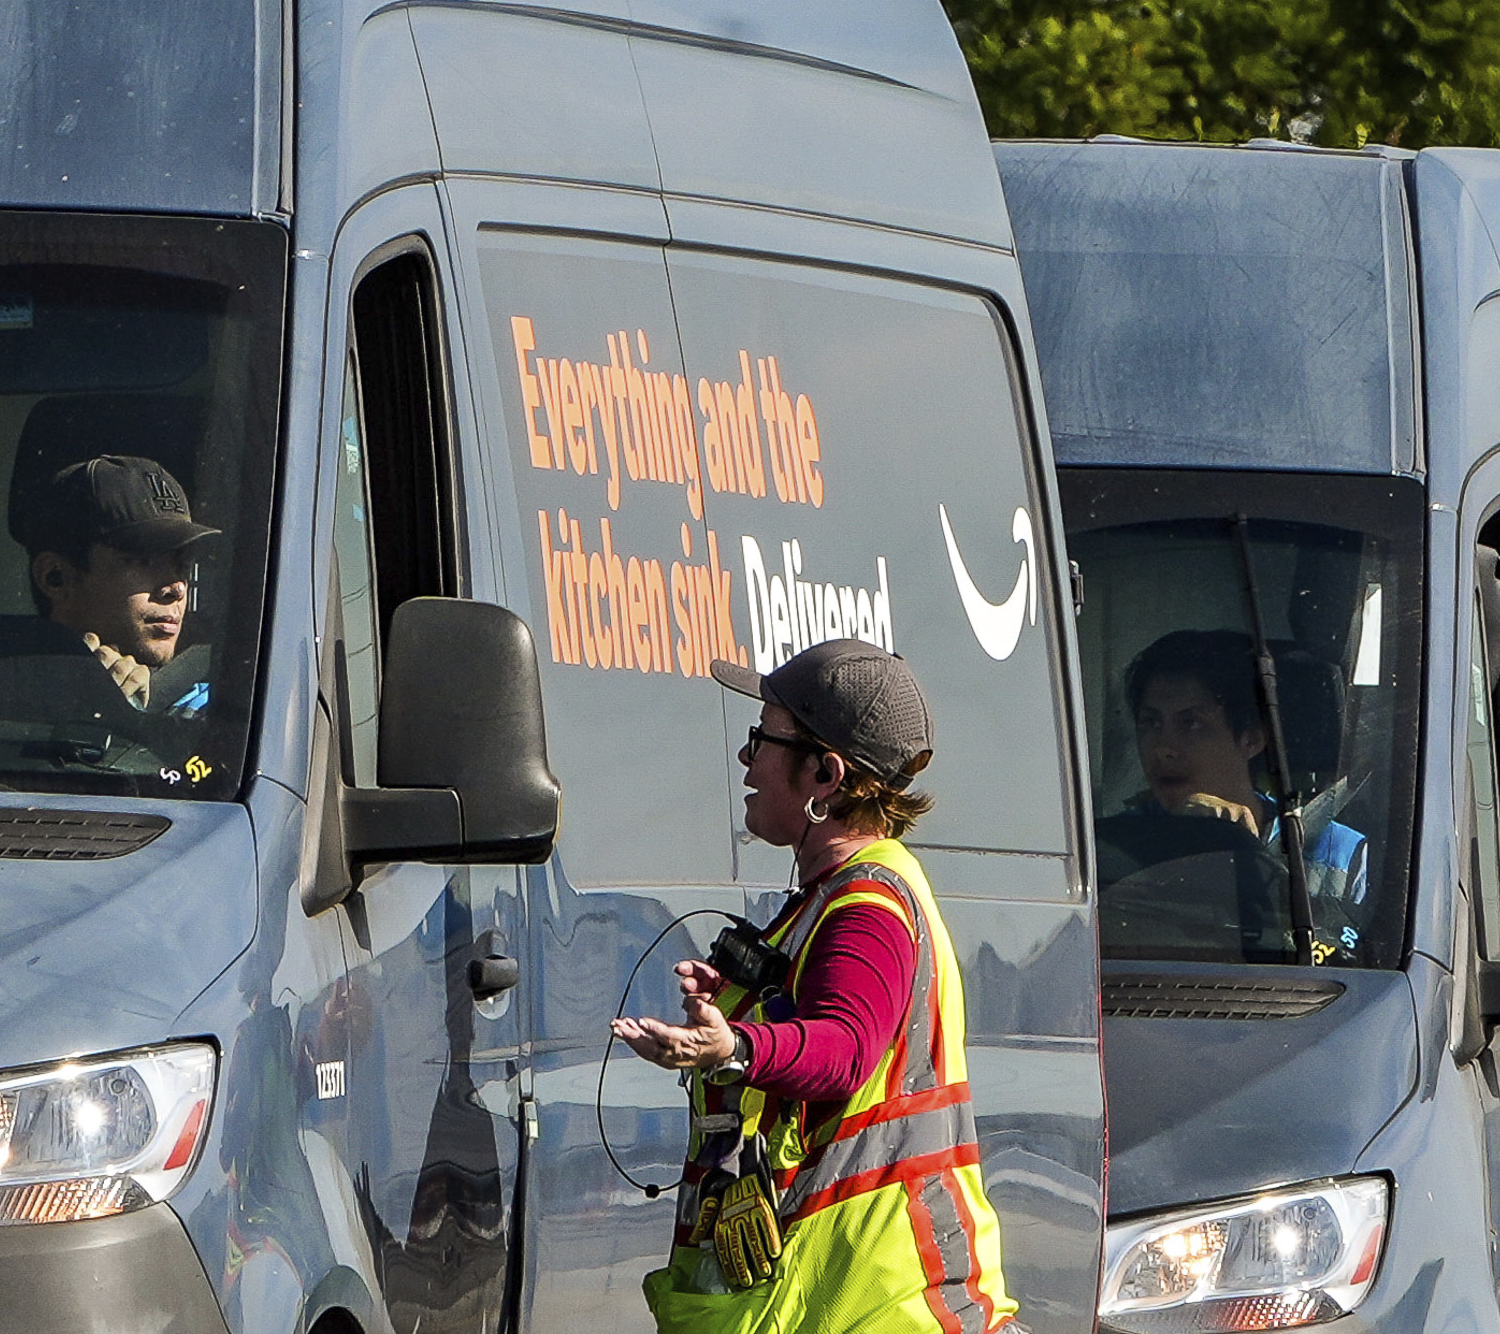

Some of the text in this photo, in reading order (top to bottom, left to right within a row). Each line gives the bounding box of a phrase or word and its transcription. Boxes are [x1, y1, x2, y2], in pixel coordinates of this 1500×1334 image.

[146, 471, 185, 514] LA
[510, 316, 825, 521] Everything and the
[537, 507, 675, 674] kitchen
[670, 521, 749, 679] sink.
